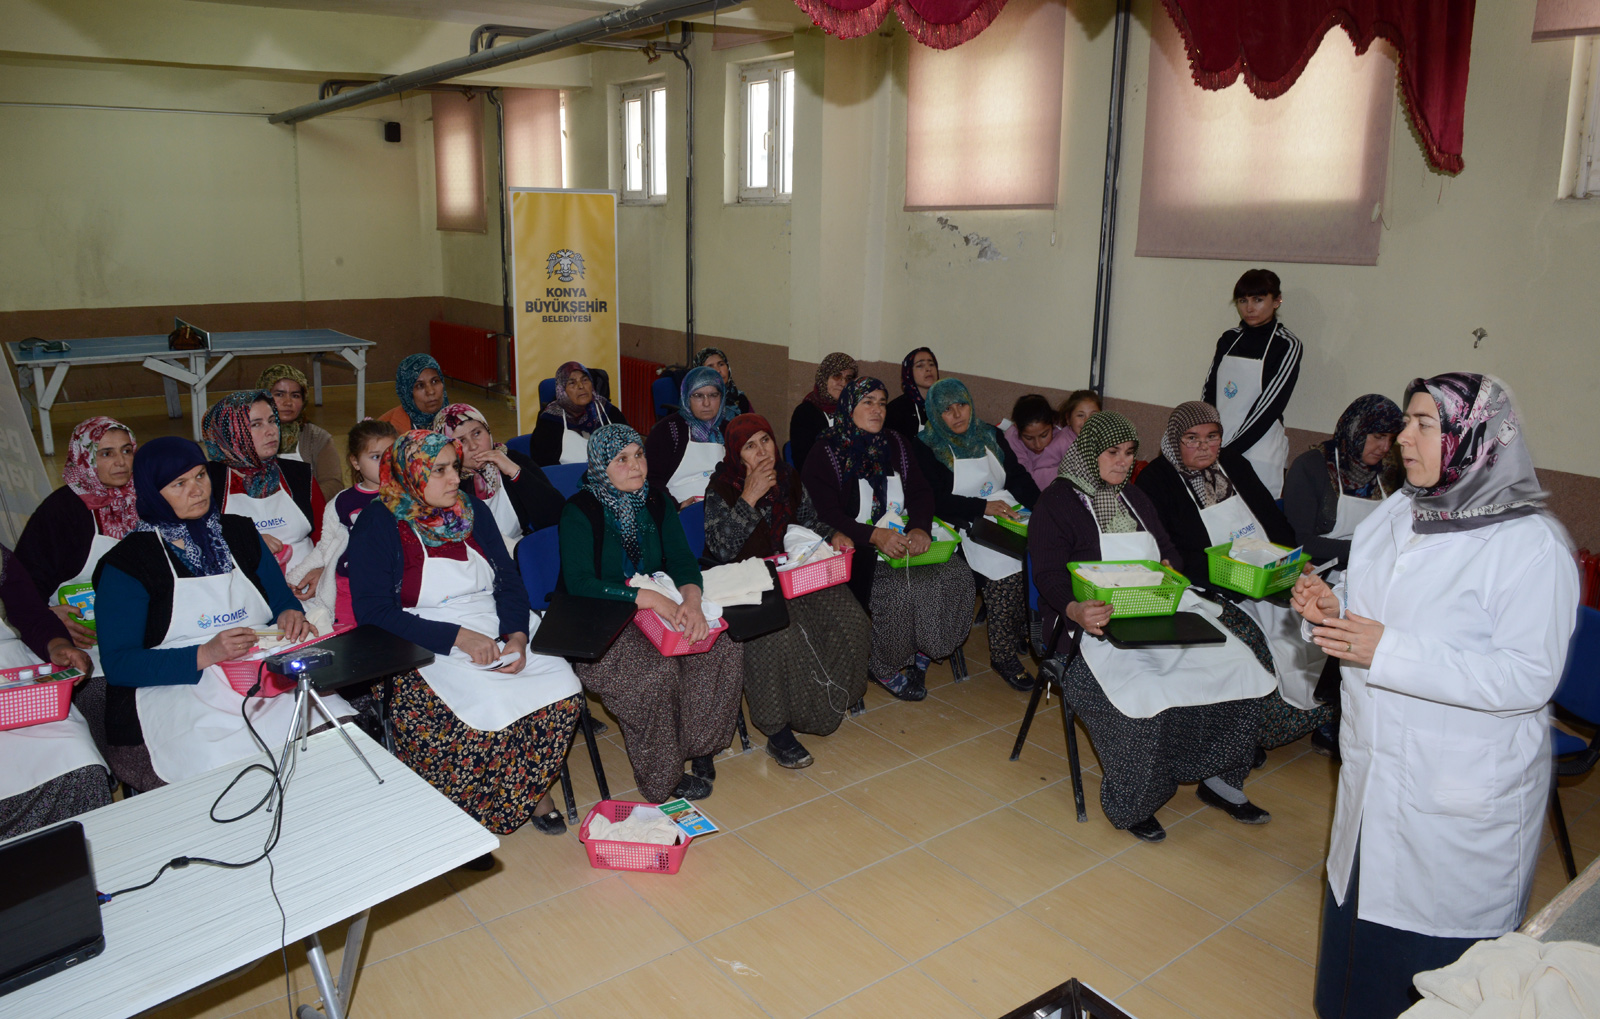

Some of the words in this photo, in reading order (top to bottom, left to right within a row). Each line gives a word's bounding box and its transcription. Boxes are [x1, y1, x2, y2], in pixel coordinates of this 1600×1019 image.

[546, 288, 587, 298] KONYA
[525, 298, 608, 314] BÜYÜKŞEHİR
[542, 314, 592, 322] BELEDİYESİ
[213, 606, 248, 624] KOMEK
